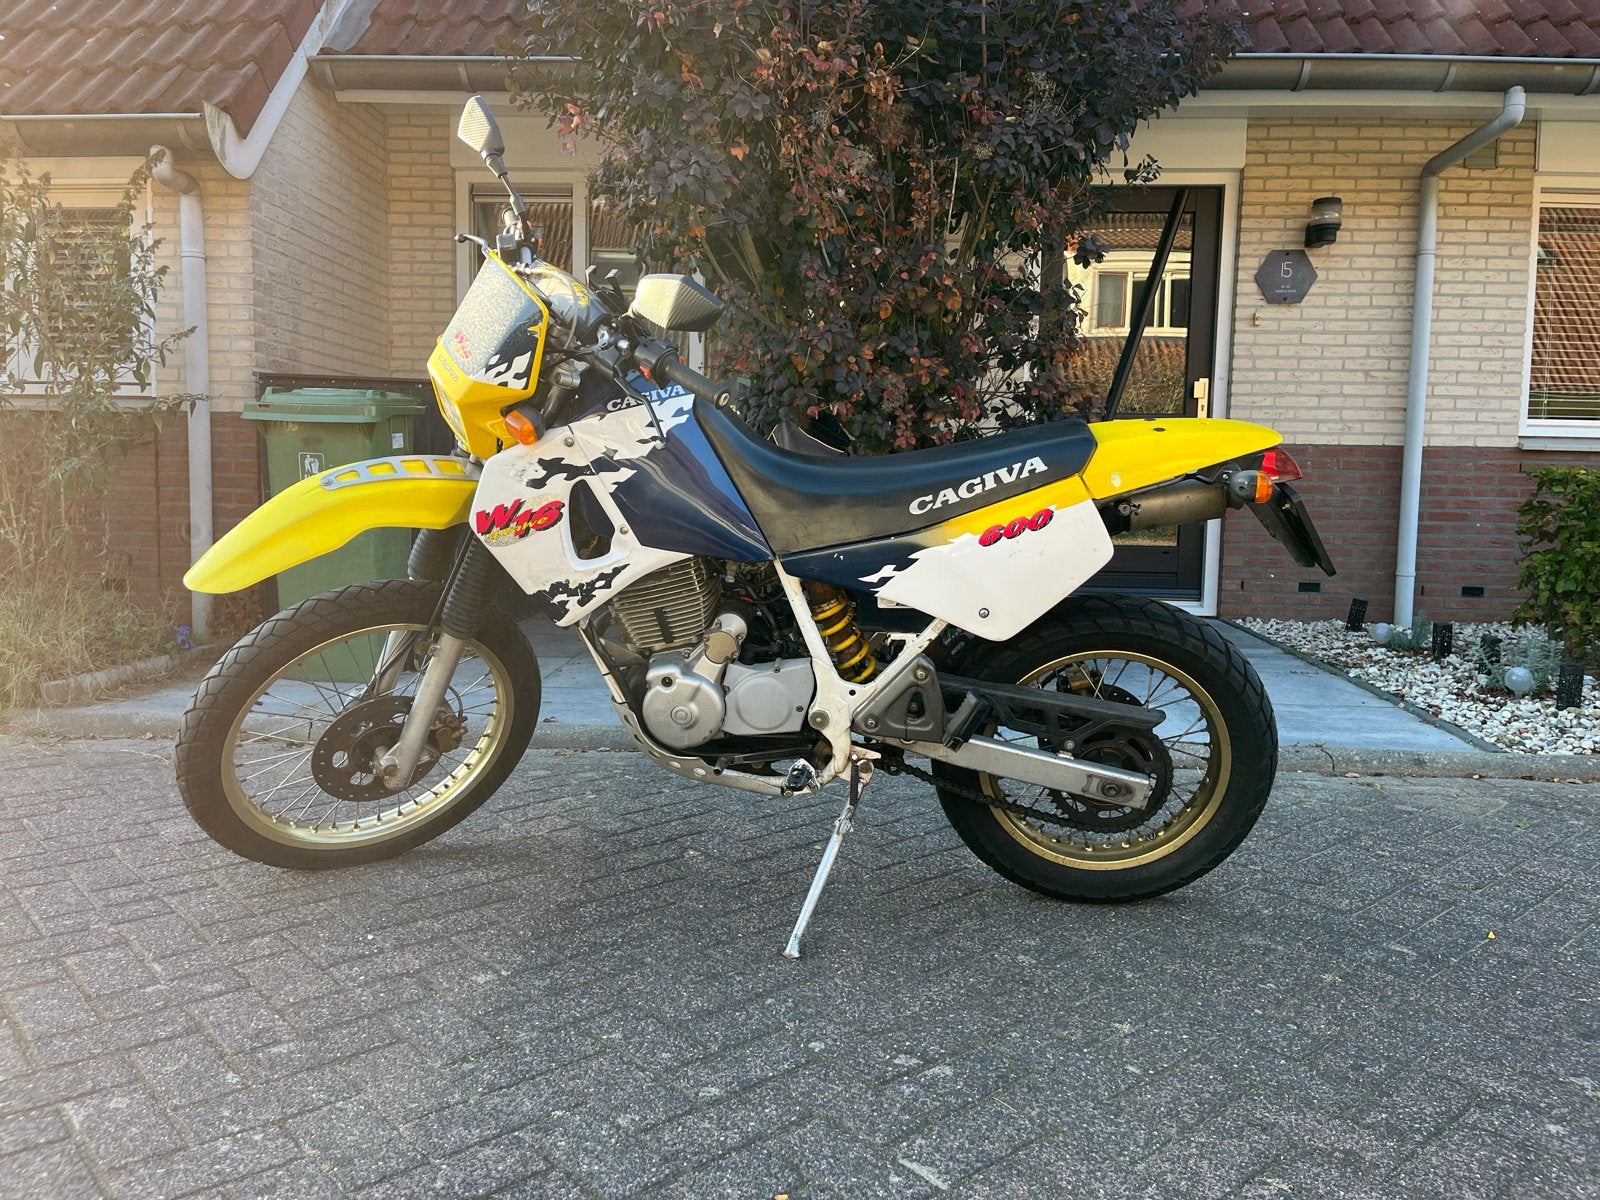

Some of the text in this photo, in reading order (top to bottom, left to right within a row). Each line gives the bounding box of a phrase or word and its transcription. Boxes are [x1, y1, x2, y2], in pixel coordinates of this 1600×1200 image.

[1280, 261, 1293, 278] 15
[908, 456, 1048, 515] CAGIVA
[476, 498, 565, 539] W16
[978, 507, 1055, 547] 600
